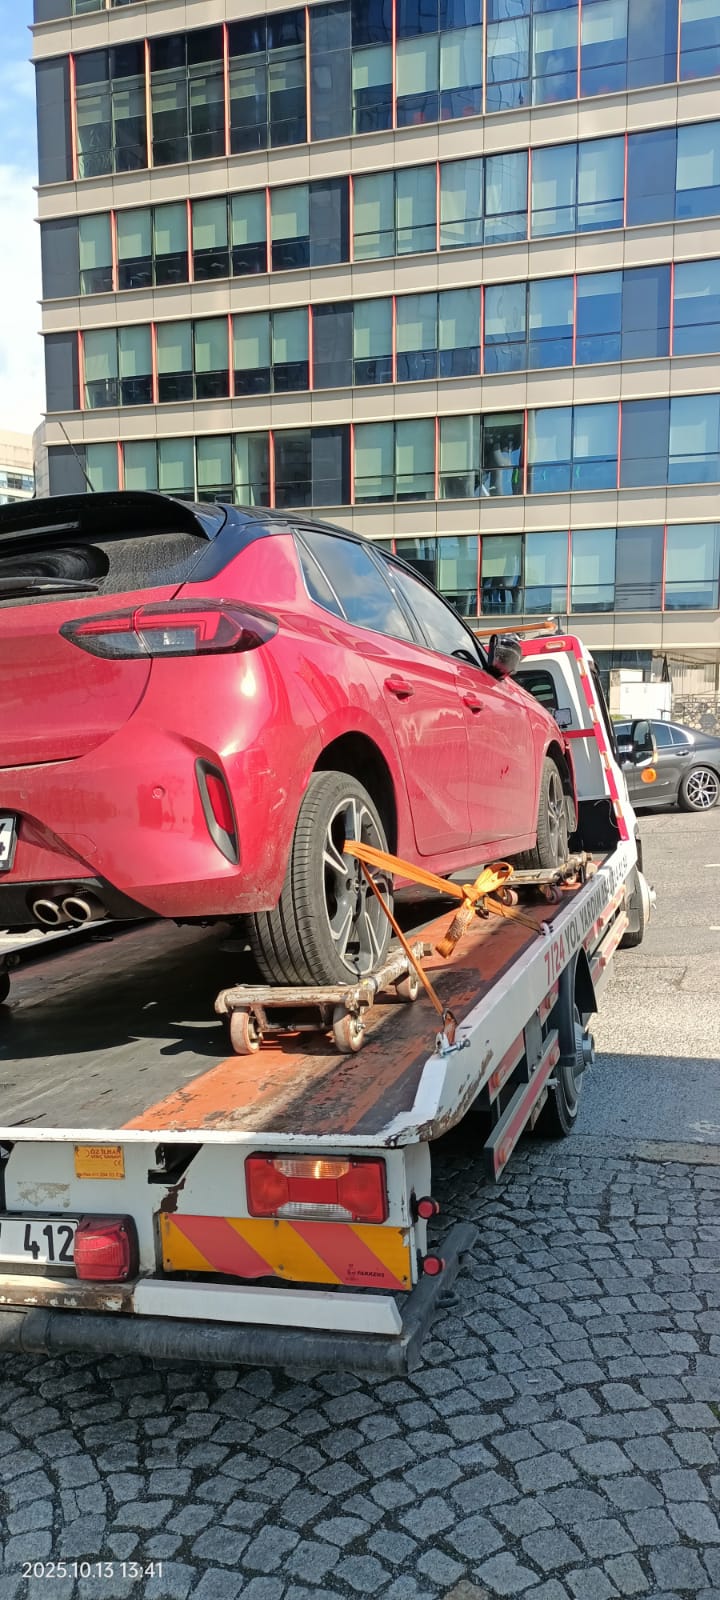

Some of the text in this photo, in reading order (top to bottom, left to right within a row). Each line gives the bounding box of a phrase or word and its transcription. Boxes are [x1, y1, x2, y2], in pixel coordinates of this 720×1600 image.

[544, 934, 565, 986] 7/24
[564, 919, 580, 955] YOL
[24, 1223, 75, 1262] 412
